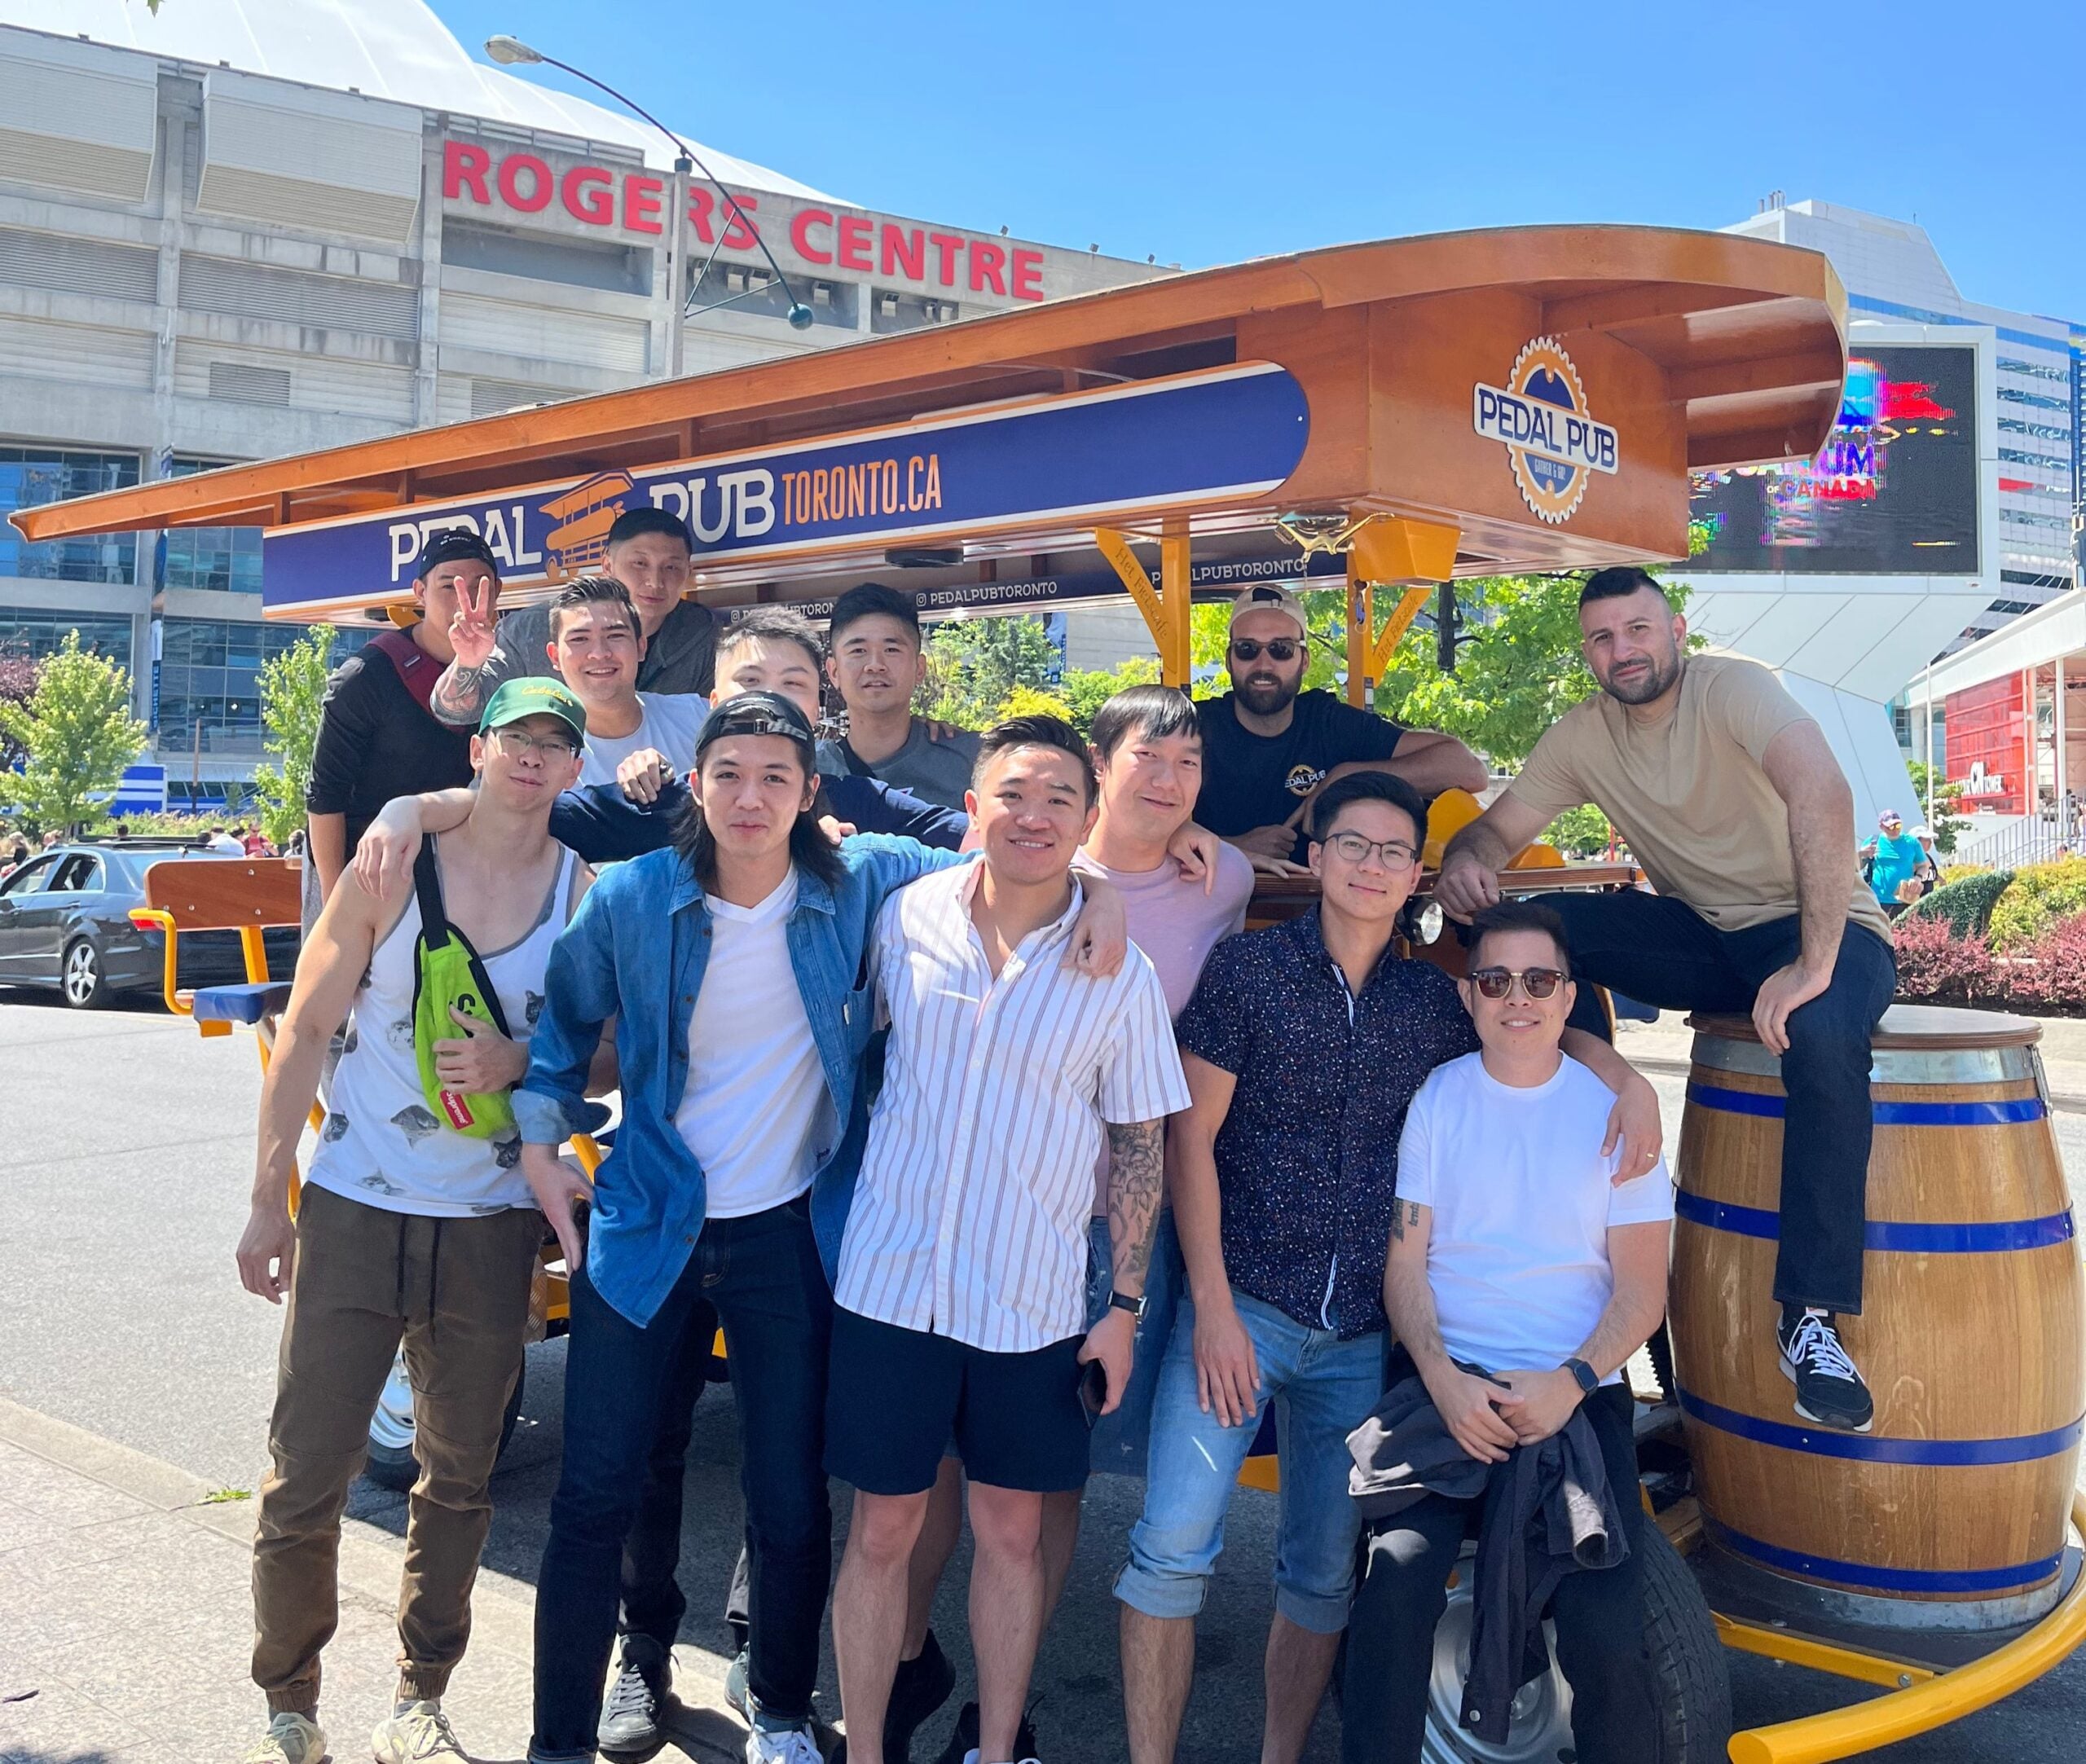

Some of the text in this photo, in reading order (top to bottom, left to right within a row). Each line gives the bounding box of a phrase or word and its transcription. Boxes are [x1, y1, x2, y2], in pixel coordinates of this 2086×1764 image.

[442, 139, 1045, 302] ROGERS CENTRE
[1478, 388, 1616, 468] PEDAL PUB
[781, 454, 942, 526] TORONTO.CA
[930, 581, 1058, 605] PEDALPUBTORONTO
[1151, 558, 1306, 584] PLPUBTORONTO
[1284, 776, 1308, 789] EDAL
